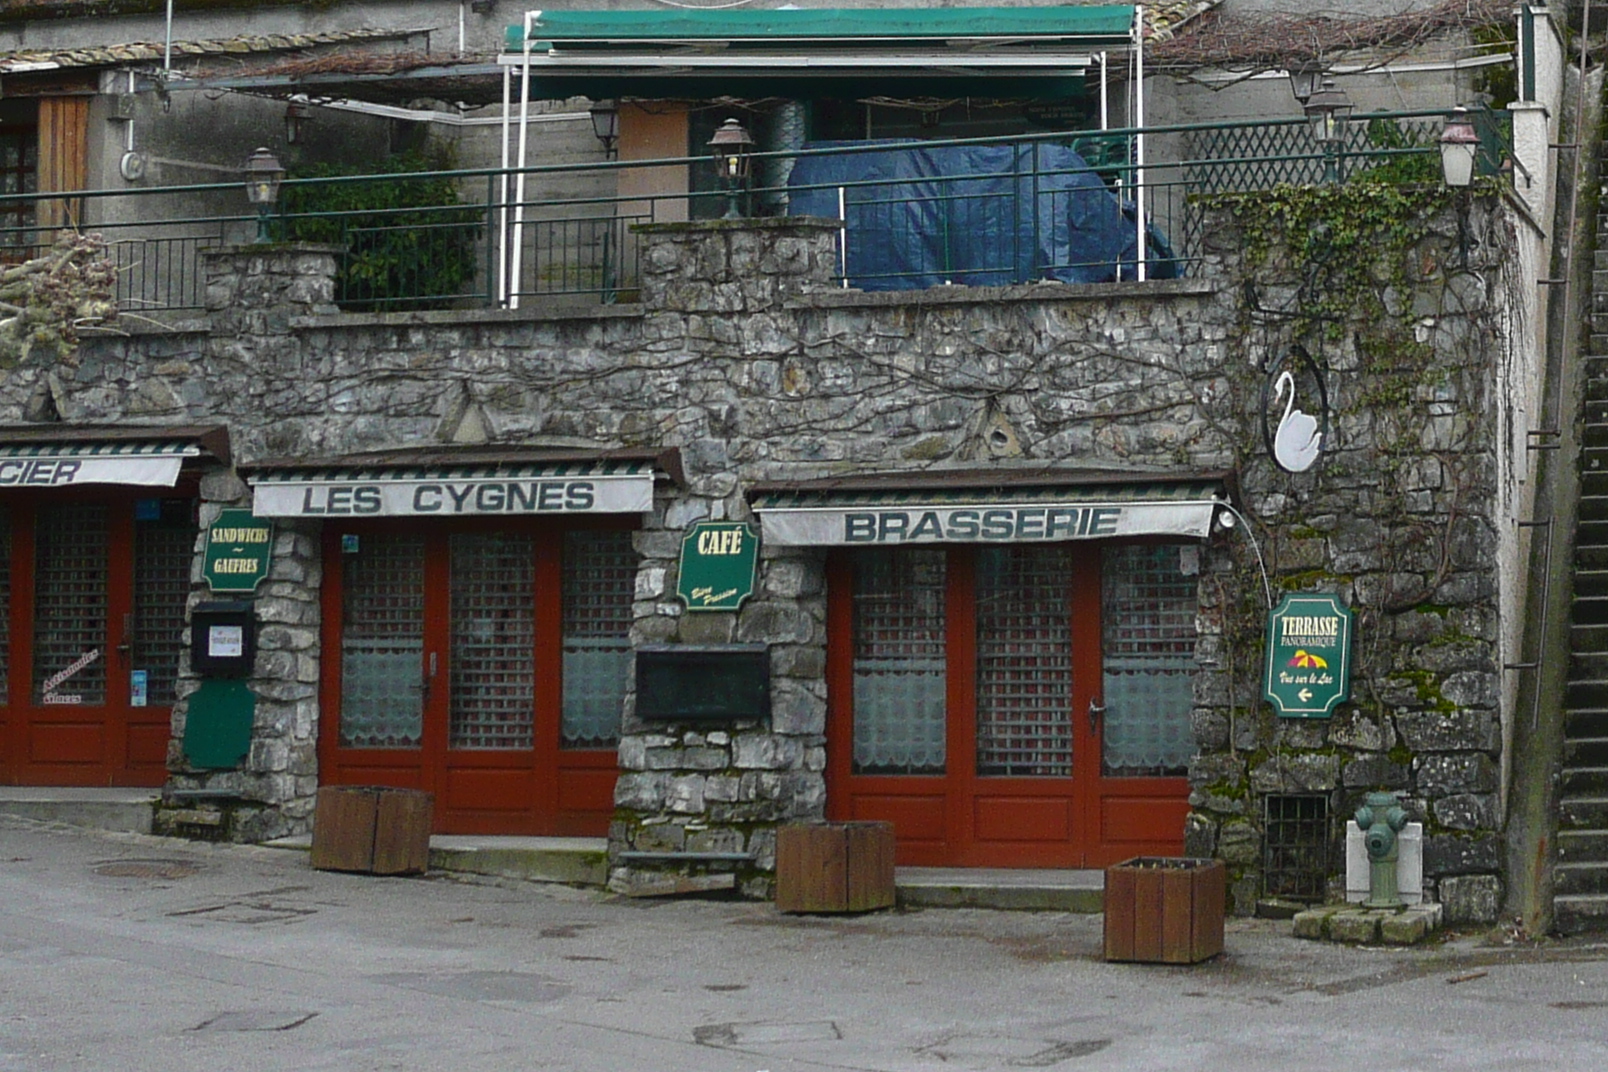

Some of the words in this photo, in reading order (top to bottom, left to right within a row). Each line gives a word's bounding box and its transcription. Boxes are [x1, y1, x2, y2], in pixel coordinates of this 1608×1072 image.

[0, 460, 83, 485] CIER
[302, 485, 383, 515] LES
[413, 481, 595, 513] CYGNES
[211, 527, 269, 543] SANDWICHS
[844, 507, 1122, 543] BRASSERIE
[697, 525, 743, 555] CAFÉ
[213, 557, 258, 574] GAUFRES
[1281, 616, 1339, 636] TERRASSE
[1280, 636, 1337, 648] PANORAMIQUE
[1279, 671, 1294, 684] Vue
[1295, 674, 1308, 684] sur
[1308, 672, 1317, 684] le
[1317, 672, 1334, 685] Lac
